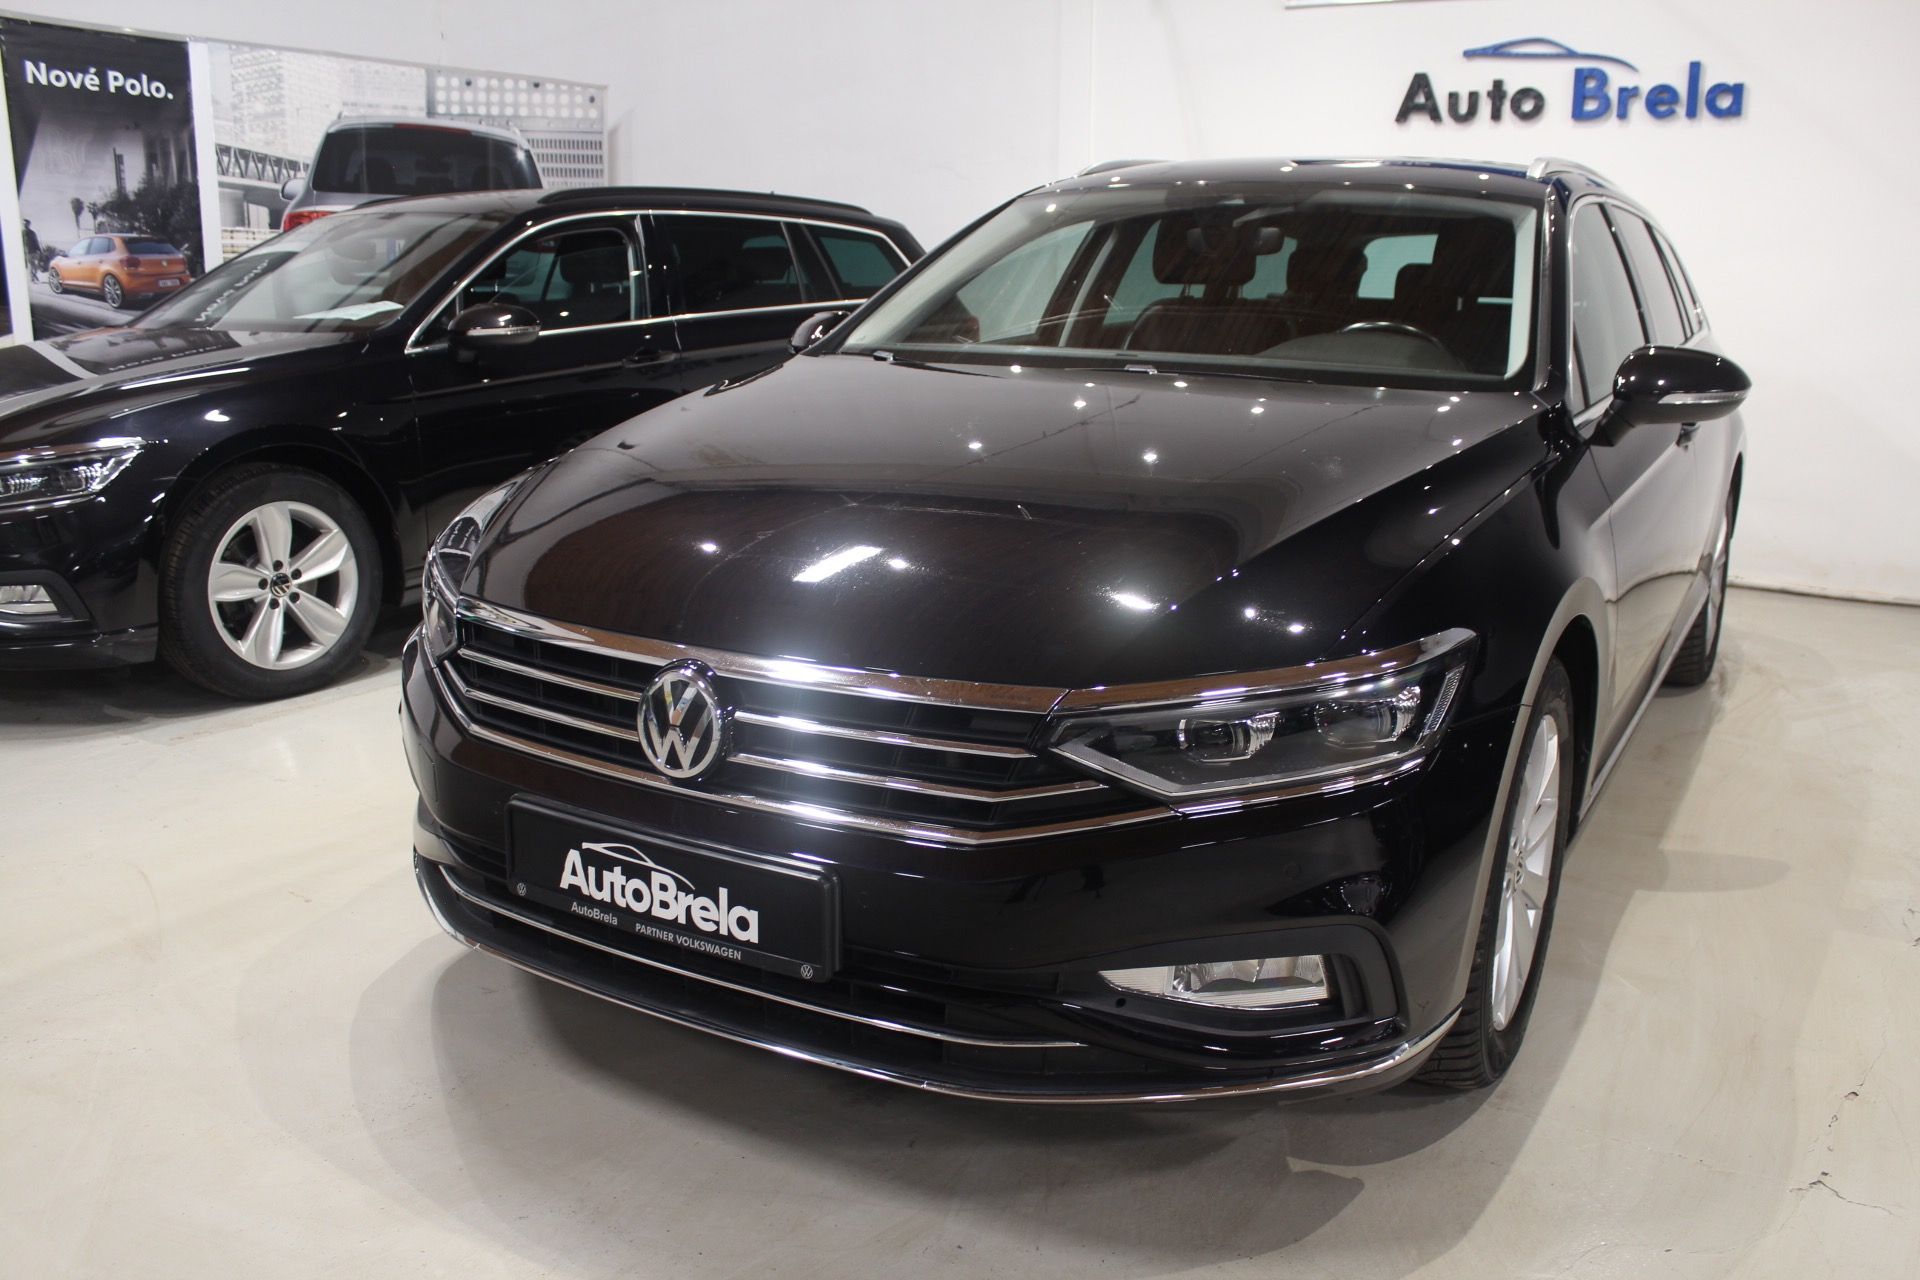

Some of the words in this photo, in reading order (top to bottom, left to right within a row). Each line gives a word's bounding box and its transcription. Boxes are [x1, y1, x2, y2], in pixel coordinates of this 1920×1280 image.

[24, 59, 100, 92] Nové
[107, 69, 174, 100] Polo.
[1395, 72, 1546, 123] Auto
[1571, 60, 1745, 121] Brela
[560, 849, 759, 944] AutoBrela
[571, 901, 618, 926] AutoBrela
[635, 922, 674, 944] PARTNER
[675, 934, 742, 961] VOLKSWAGEN
